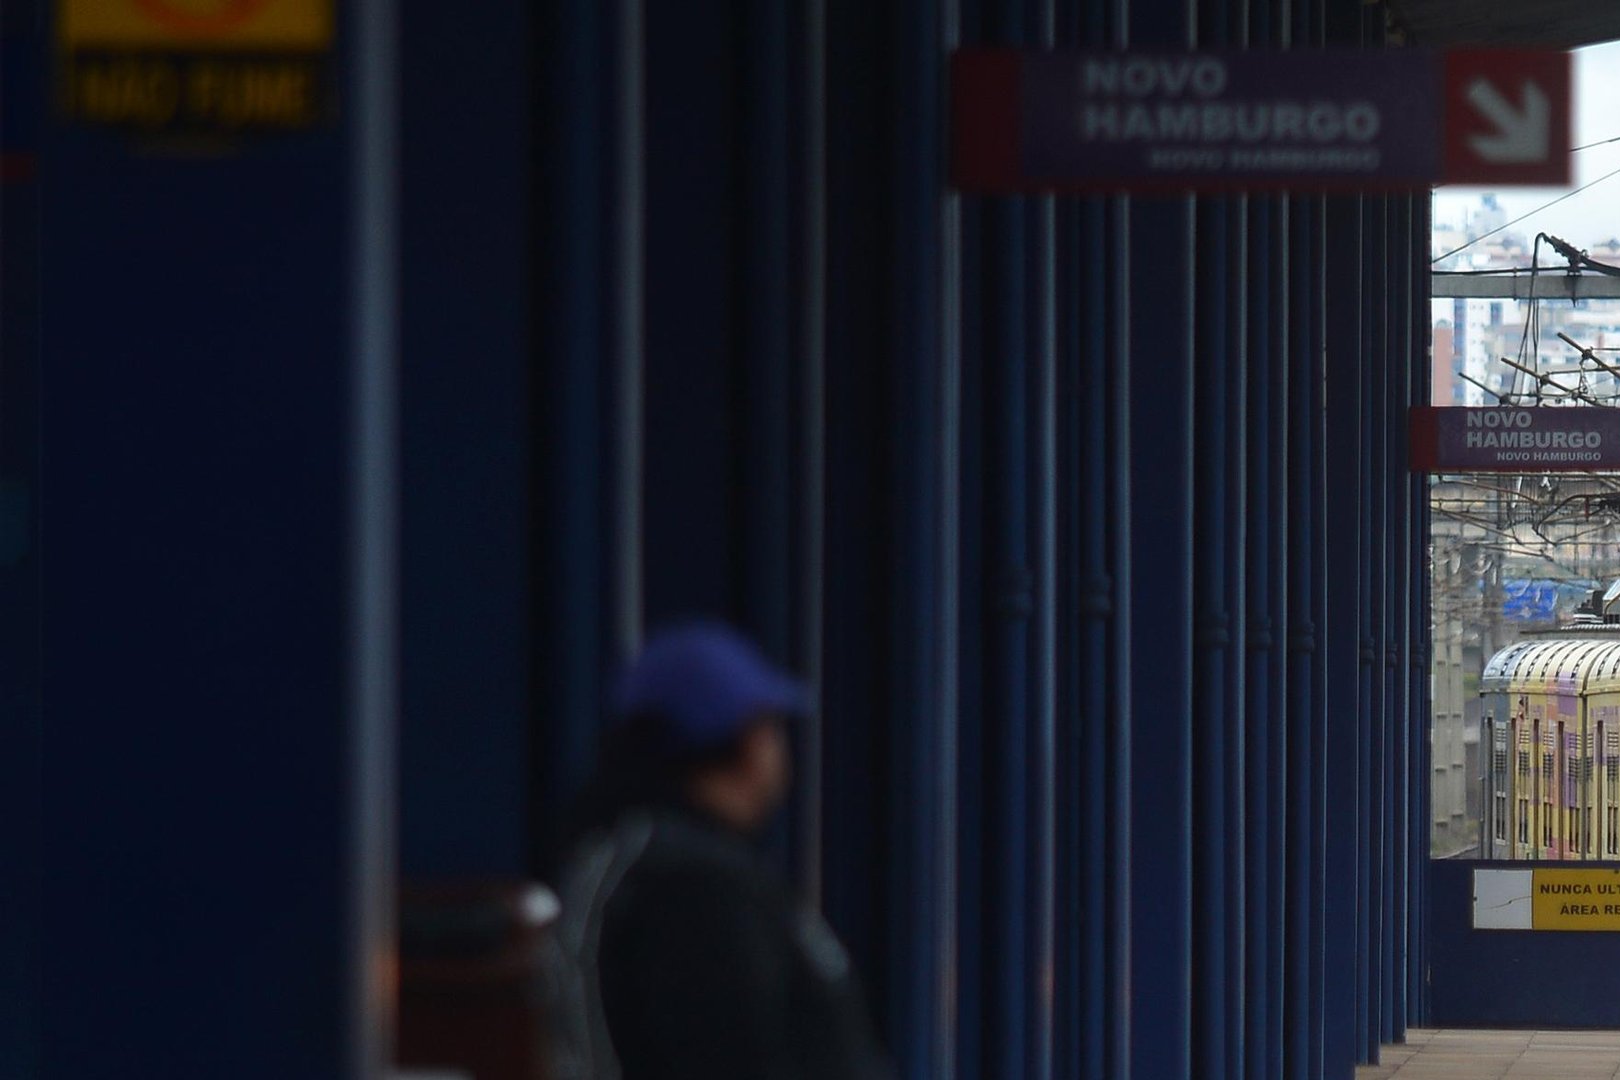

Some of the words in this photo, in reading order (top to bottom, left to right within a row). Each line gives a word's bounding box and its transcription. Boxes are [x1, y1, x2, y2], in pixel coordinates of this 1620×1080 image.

[1083, 58, 1228, 97] NOVO
[1083, 103, 1380, 141] HAMBURGO
[1149, 150, 1224, 170] NOVO
[1230, 150, 1380, 171] HAMBURGO
[1466, 411, 1532, 428] NOVO
[1466, 430, 1602, 449] HAMBURGO
[1496, 451, 1531, 462] NOVO
[1533, 452, 1602, 462] HAMBURGO
[1540, 884, 1592, 896] NUNCA
[1560, 903, 1599, 915] ÁREA
